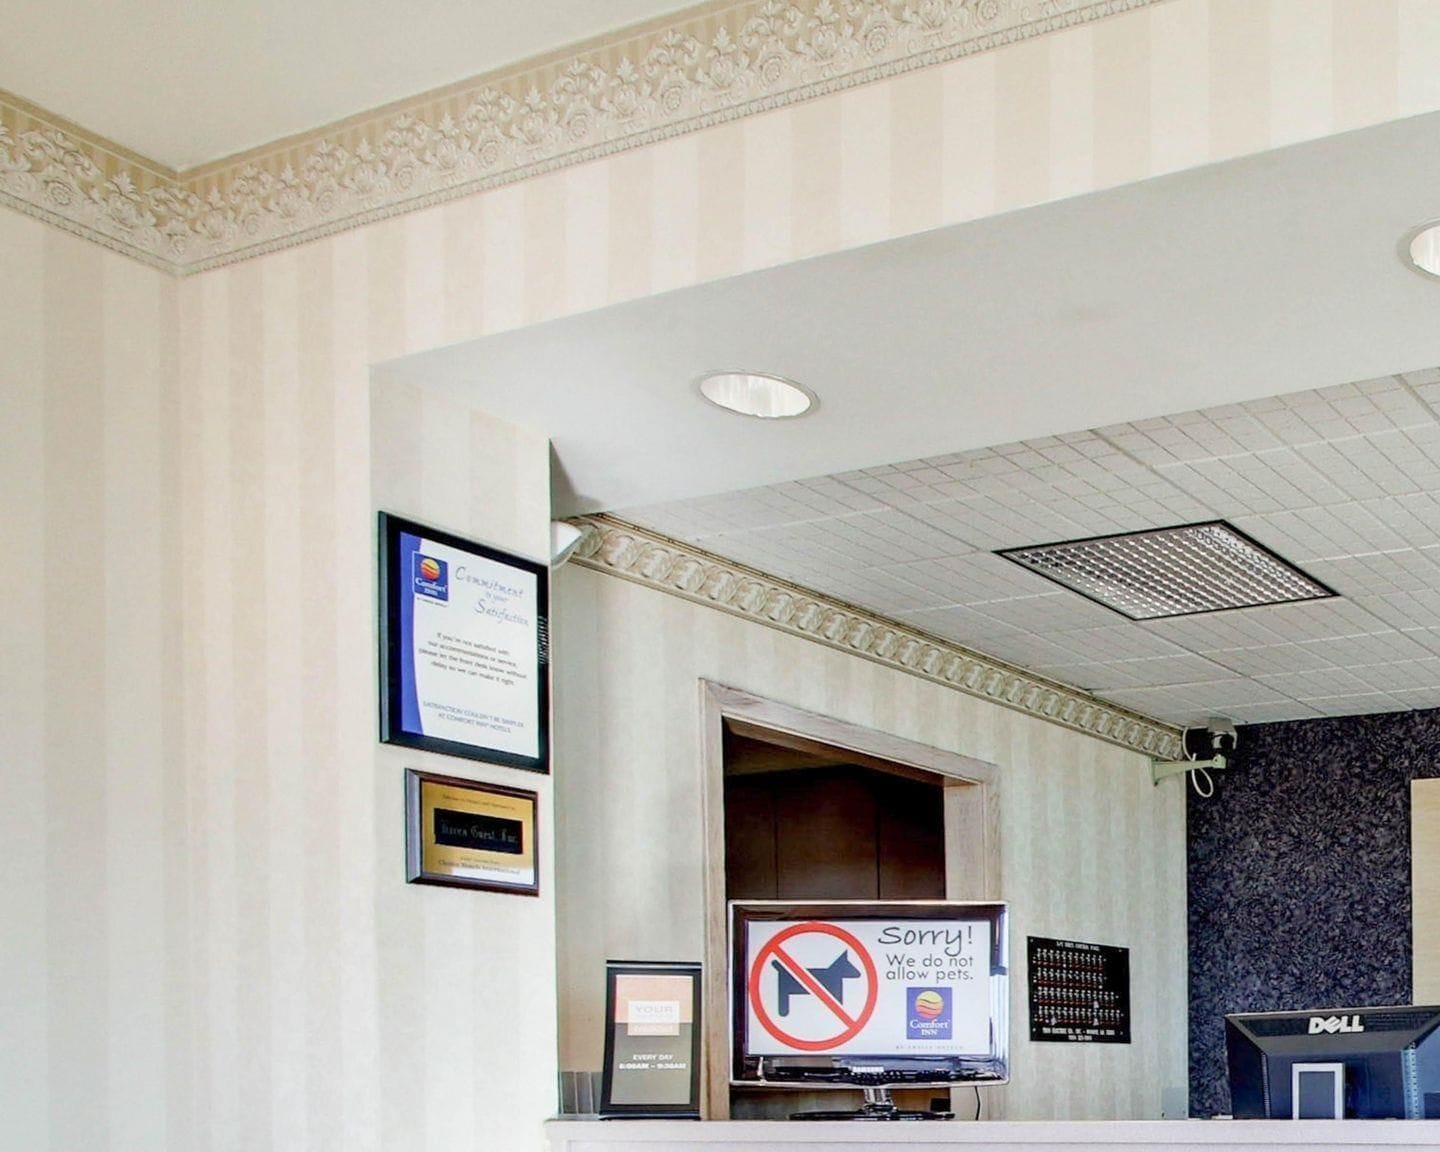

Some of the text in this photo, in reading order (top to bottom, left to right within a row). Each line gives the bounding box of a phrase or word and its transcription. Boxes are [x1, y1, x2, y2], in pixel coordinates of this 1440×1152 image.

[415, 577, 448, 593] Comfort
[455, 566, 524, 598] Commitment
[475, 599, 529, 625] Satisfaction
[878, 925, 973, 957] Sorry!
[886, 953, 974, 967] We do not
[886, 967, 974, 984] allow pets.
[910, 1018, 950, 1030] Comfort
[1308, 1015, 1364, 1034] DELL
